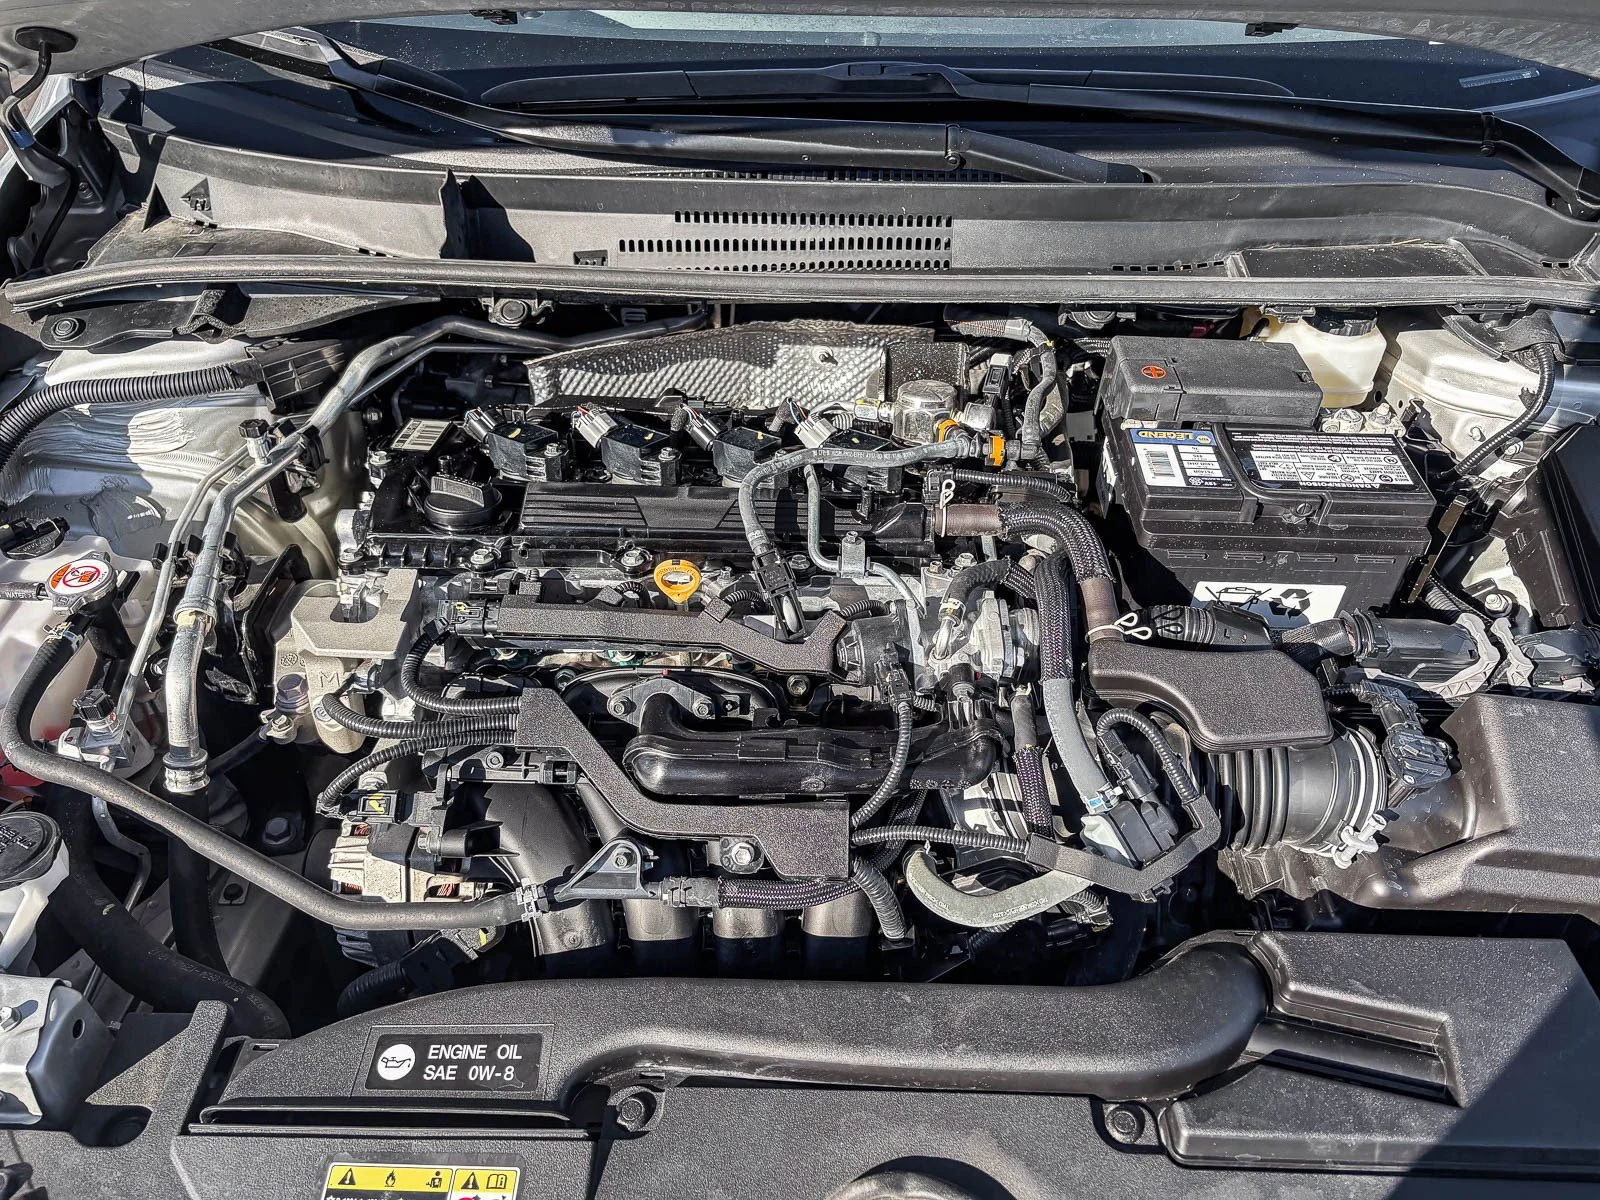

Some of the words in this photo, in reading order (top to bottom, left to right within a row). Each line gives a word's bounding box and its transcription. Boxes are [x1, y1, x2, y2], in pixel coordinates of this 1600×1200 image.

[427, 1044, 487, 1060] ENGINE
[497, 1044, 522, 1060] OIL
[423, 1064, 458, 1081] SAE
[468, 1065, 515, 1081] 0W-8
